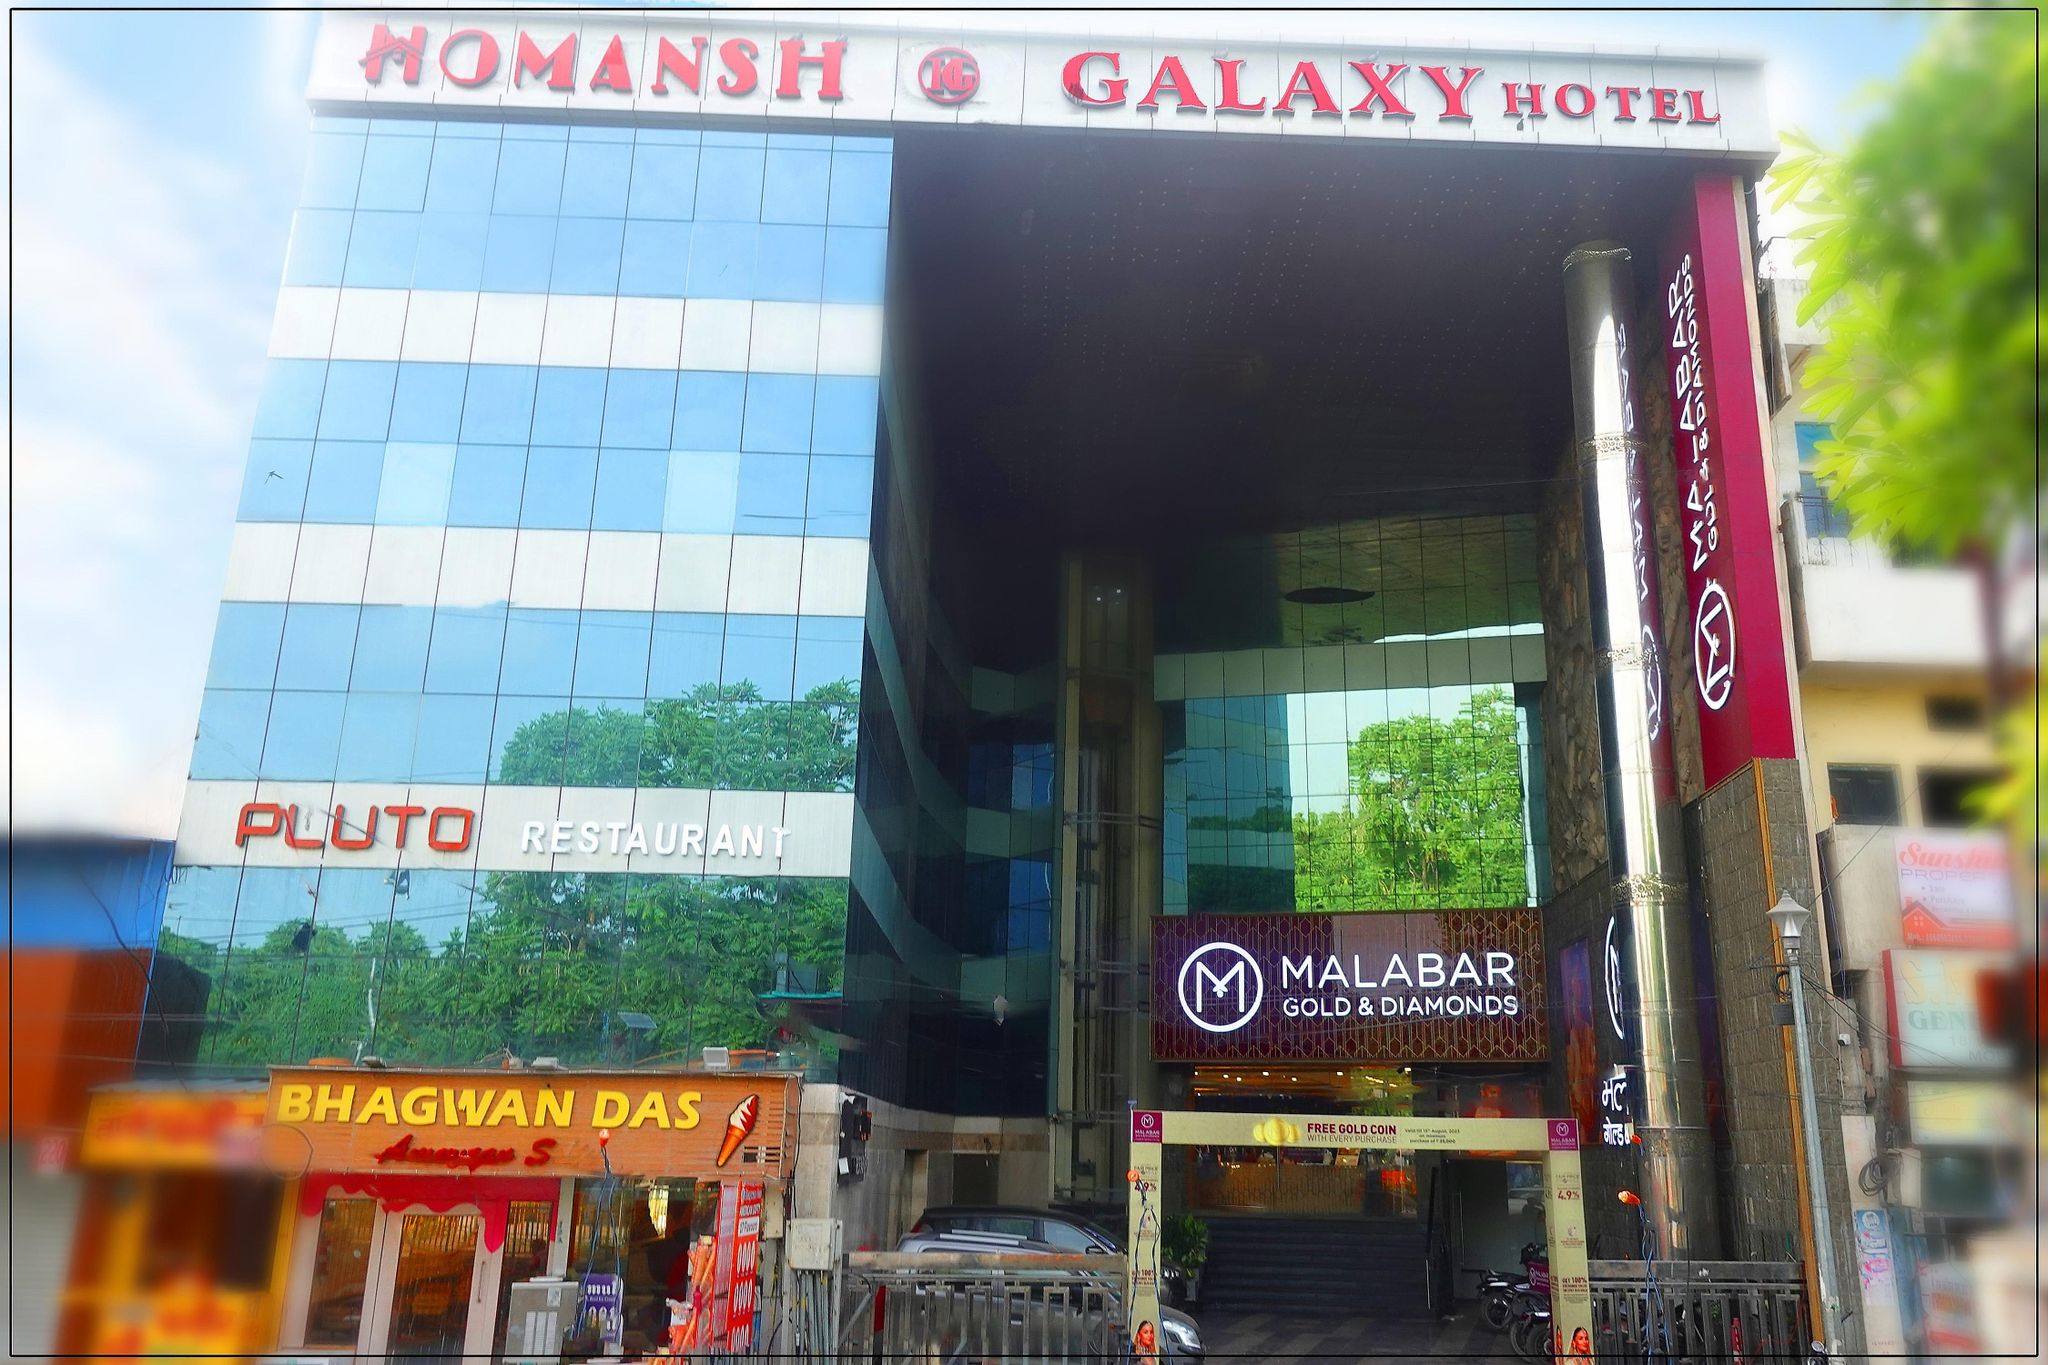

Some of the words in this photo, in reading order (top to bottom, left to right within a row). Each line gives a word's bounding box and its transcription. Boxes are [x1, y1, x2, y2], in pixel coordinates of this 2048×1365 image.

[358, 23, 848, 101] HOMANSH
[1061, 51, 1485, 120] GALAXY
[1501, 82, 1722, 126] HOTEL
[235, 802, 475, 852] PLUTO
[521, 820, 791, 859] RESTAURANT
[1281, 952, 1517, 989] MALABAR
[1283, 996, 1351, 1017] GOLD
[1358, 996, 1375, 1016] &
[1381, 995, 1518, 1016] DIAMONDS
[276, 1084, 575, 1128] BHAGWAN
[592, 1090, 702, 1129] DAS
[1307, 1123, 1336, 1133] FREE
[1338, 1124, 1368, 1134] GOLD
[1370, 1125, 1397, 1135] COIN
[1307, 1134, 1327, 1142] WITH
[1329, 1135, 1353, 1143] EVERY
[1354, 1135, 1397, 1144] PURCHASE
[1558, 1190, 1580, 1200] 4.9%
